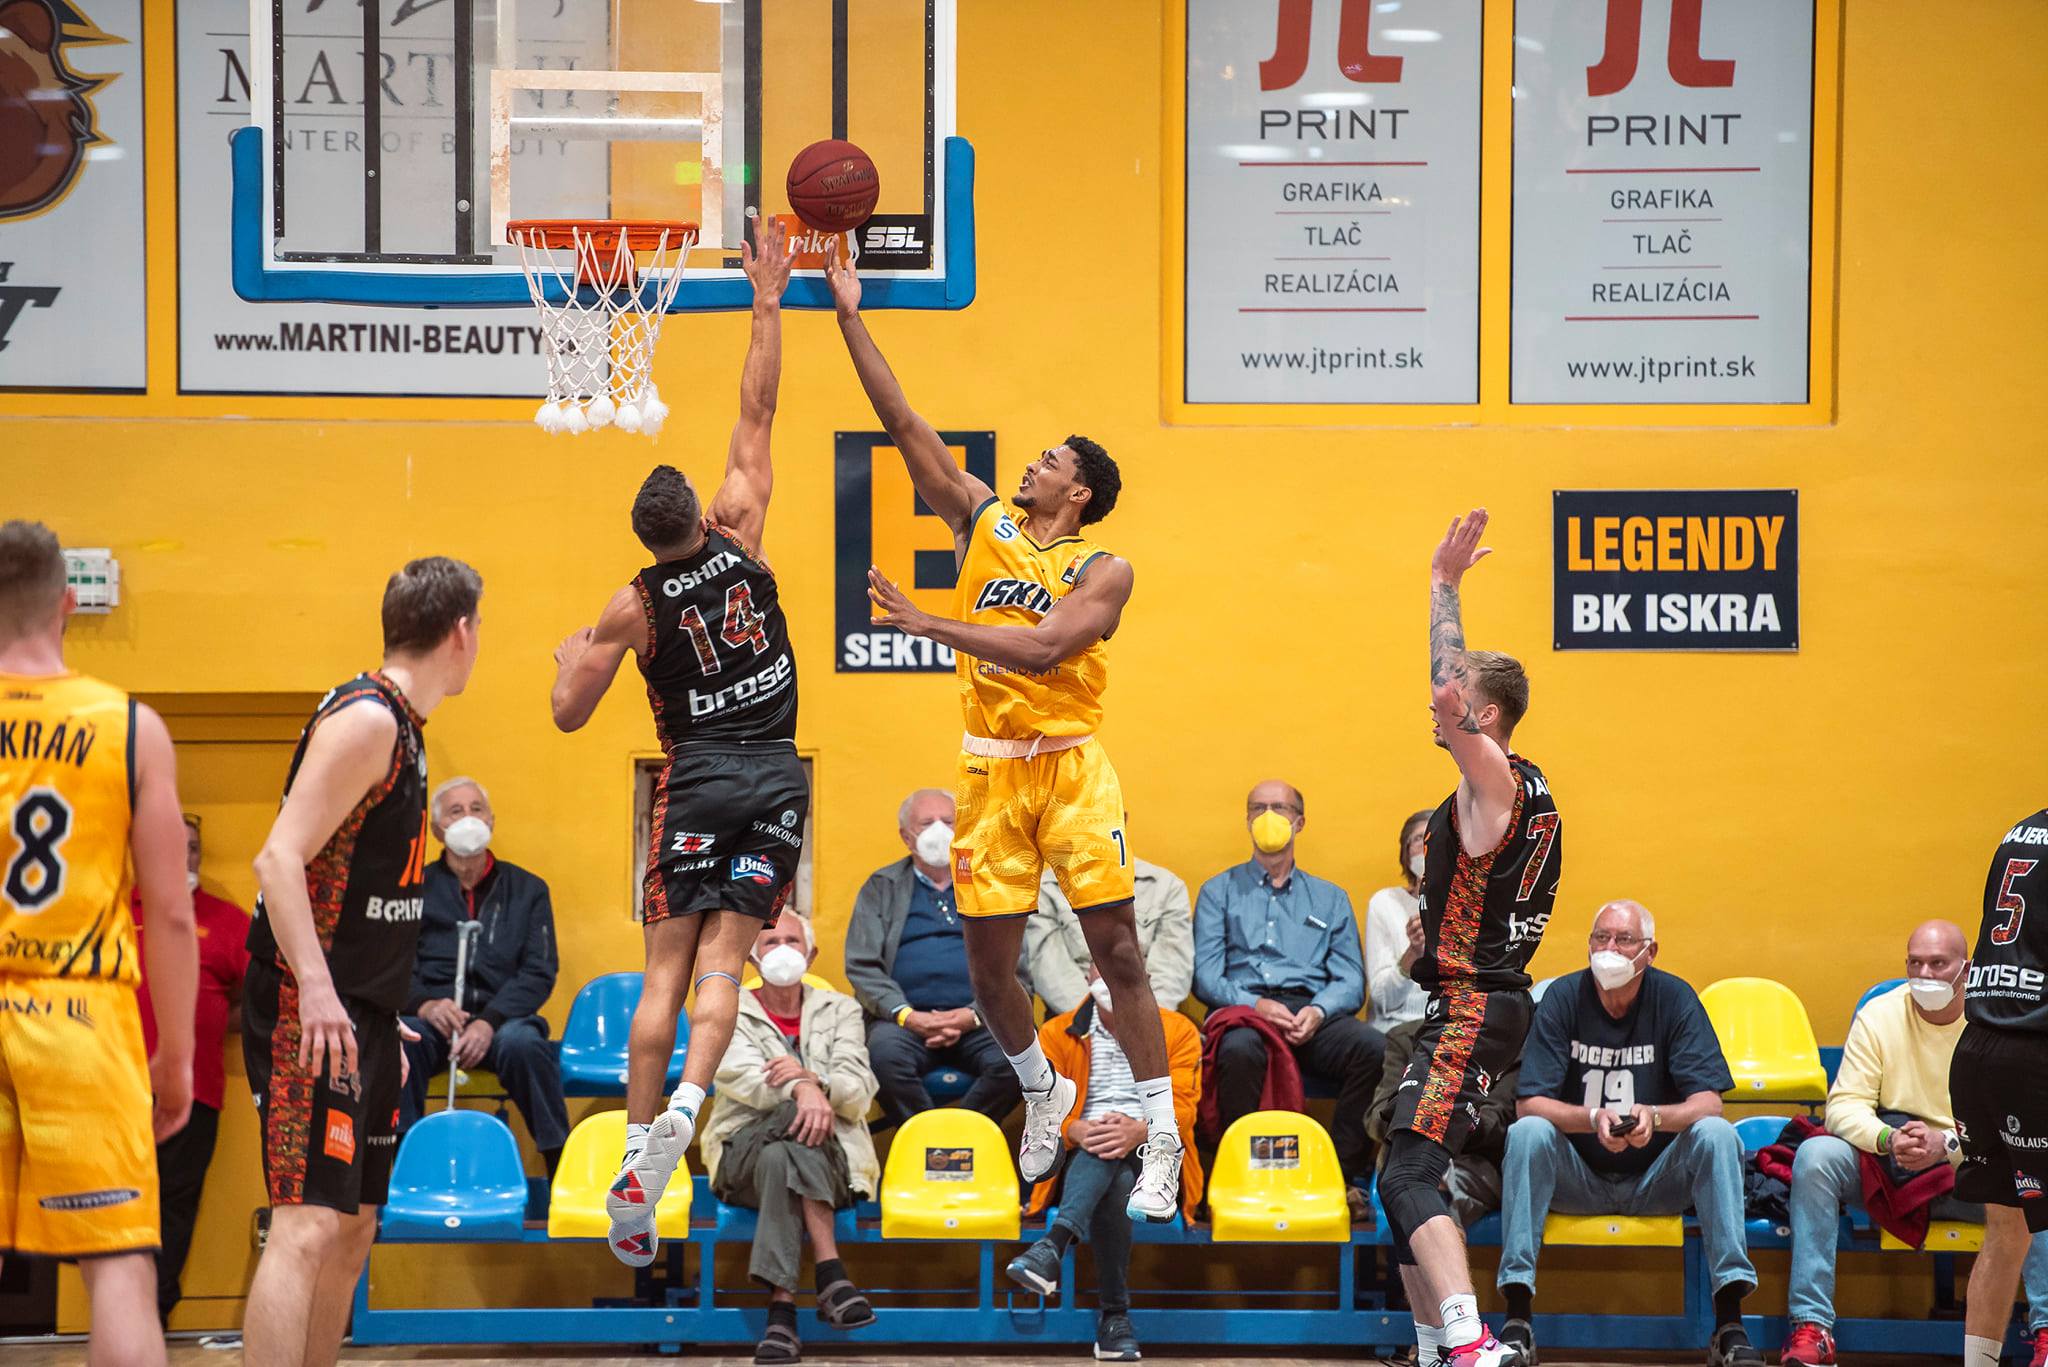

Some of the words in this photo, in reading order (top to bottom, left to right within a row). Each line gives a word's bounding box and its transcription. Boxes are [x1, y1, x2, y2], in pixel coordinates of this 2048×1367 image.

[1260, 109, 1409, 140] PRINT
[1587, 114, 1742, 146] PRINT
[1283, 182, 1383, 202] GRAFIKA
[1610, 189, 1714, 209] GRAFIKA
[865, 226, 924, 248] SBL
[1304, 222, 1362, 246] TLAČ
[1633, 229, 1692, 254] TLAČ
[1265, 269, 1399, 293] REALIZÁCIA
[1592, 277, 1731, 302] REALIZÁCIA
[1241, 347, 1424, 374] www.jtprint.sk
[1567, 355, 1756, 383] www.jtprint.sk
[1567, 515, 1786, 573] LEGENDY
[662, 551, 743, 598] OSHITA
[678, 579, 770, 676] 14
[1573, 593, 1632, 633] BK
[1645, 593, 1782, 633] ISKRA
[688, 653, 792, 717] brose
[2, 786, 73, 914] 8
[1990, 858, 2040, 945] 5
[1966, 959, 2045, 991] brose
[1570, 1040, 1655, 1067] TOGETHER
[1582, 1069, 1635, 1116] 19
